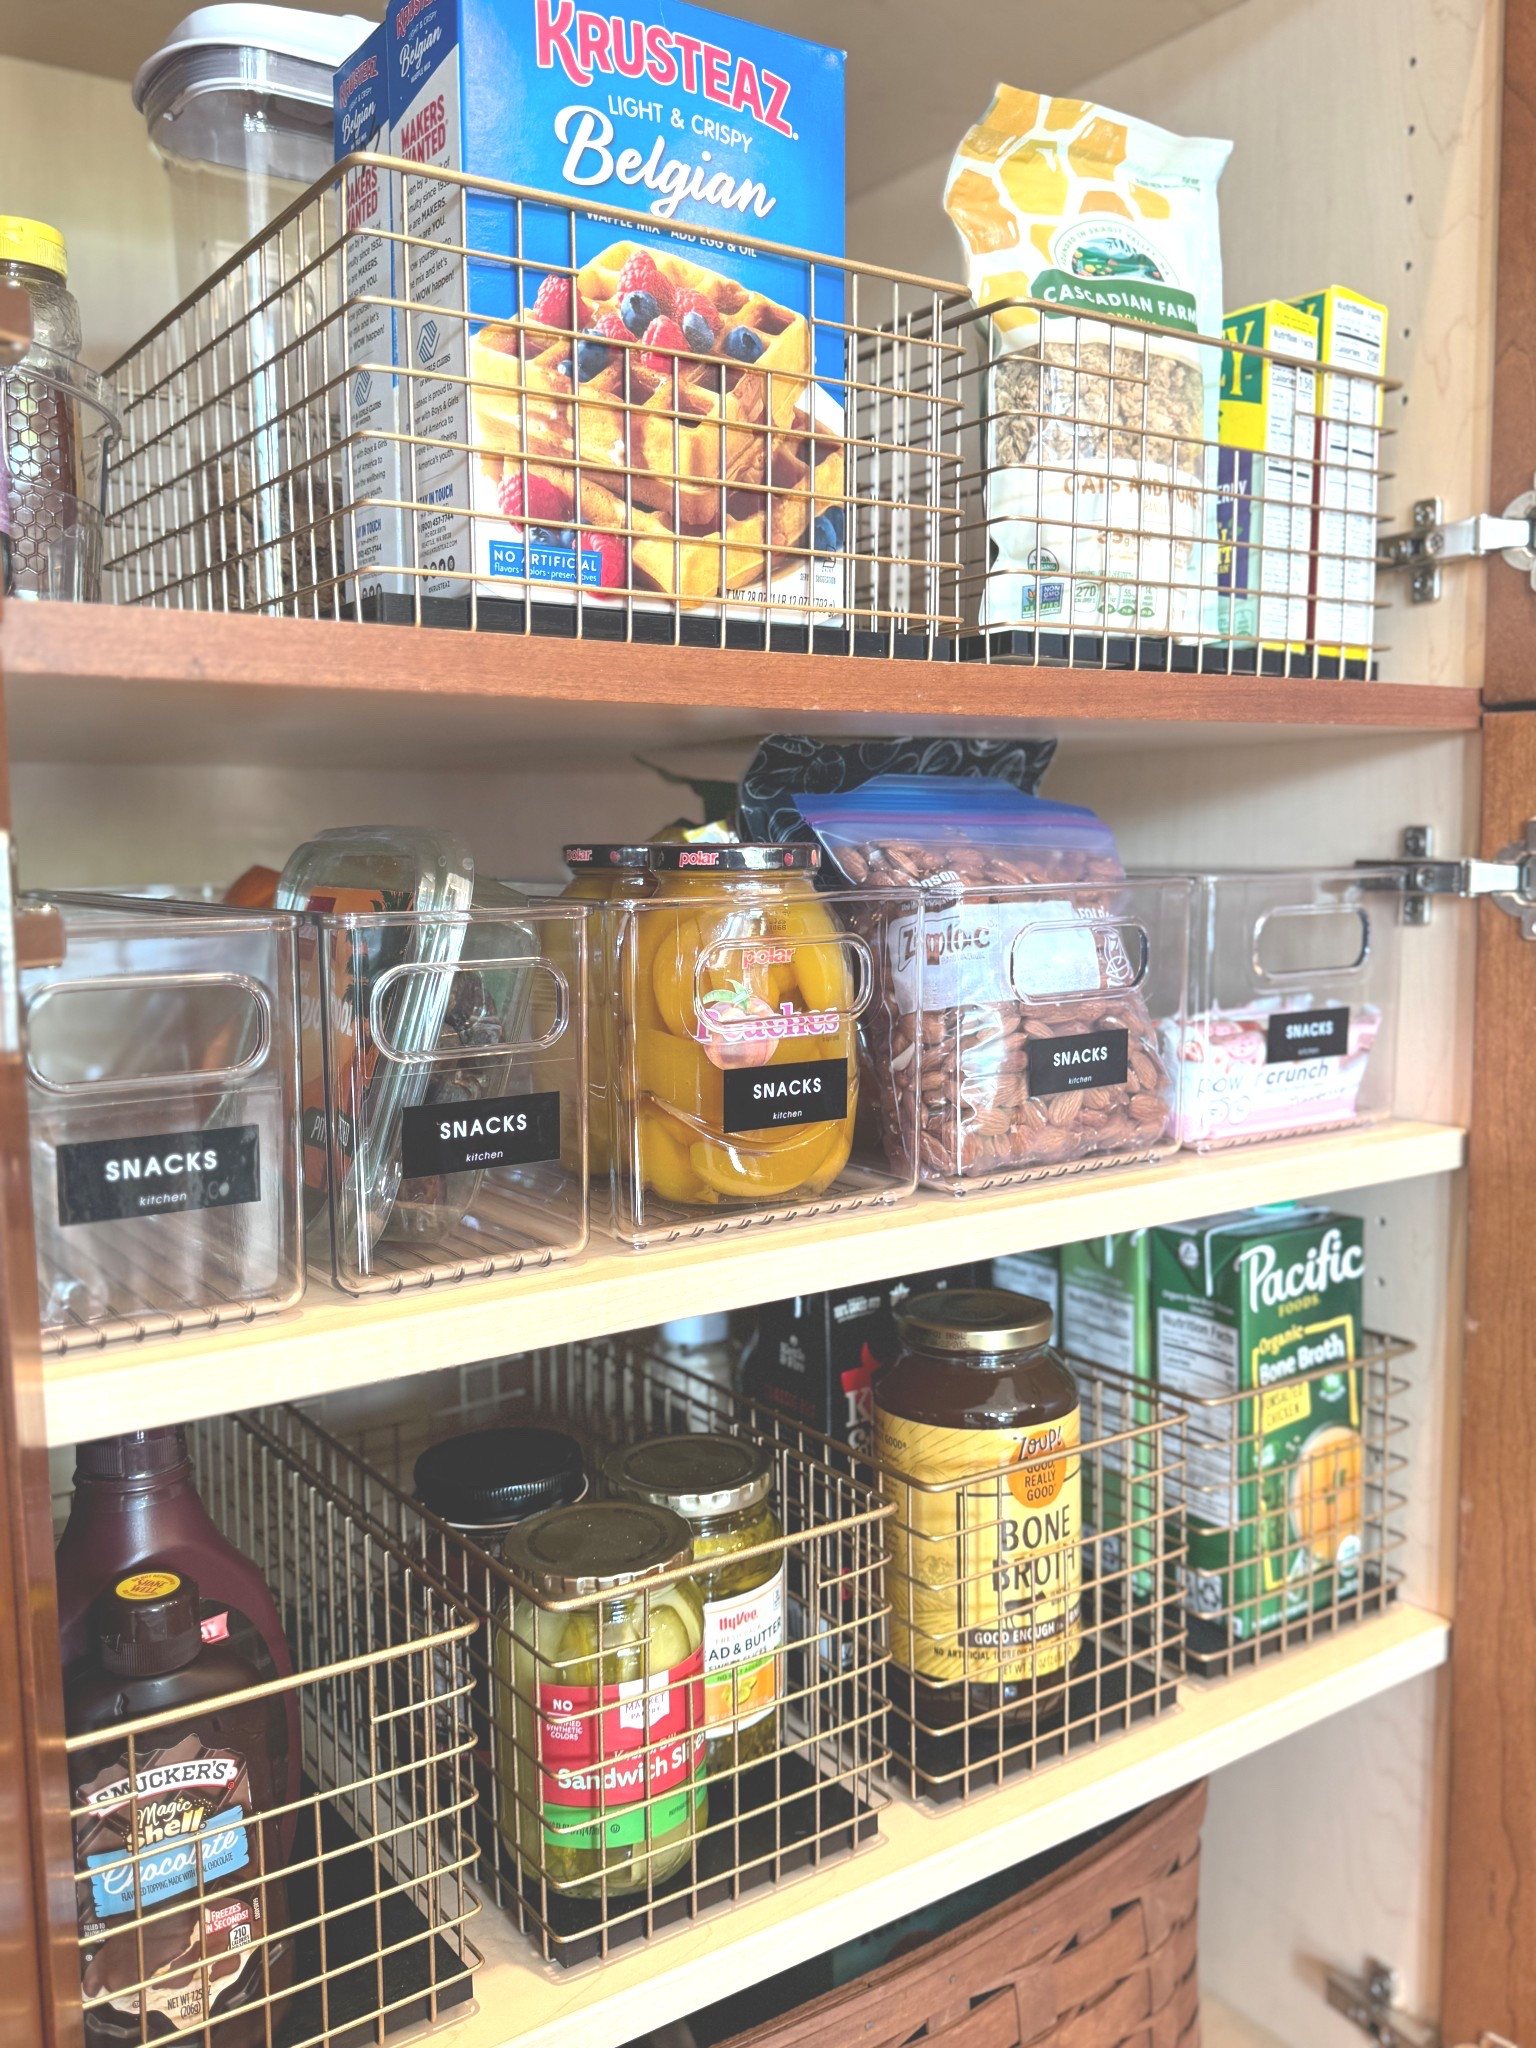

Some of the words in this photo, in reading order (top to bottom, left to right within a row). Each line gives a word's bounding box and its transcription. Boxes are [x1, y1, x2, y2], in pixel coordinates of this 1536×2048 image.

[400, 26, 442, 77] Belgian
[401, 94, 445, 149] MAKERS
[608, 97, 663, 125] LIGHT
[672, 108, 685, 128] &
[691, 114, 753, 153] CRISPY
[553, 103, 776, 219] Belgian
[431, 270, 455, 293] happen!
[1043, 284, 1153, 314] CASCADIAN
[1157, 300, 1197, 324] FARM
[435, 483, 454, 502] TOUCH
[494, 549, 516, 563] NO
[521, 553, 597, 572] RTIFICAL
[494, 561, 520, 574] flavors
[1075, 585, 1097, 598] 270
[679, 851, 717, 867] polar
[742, 947, 796, 970] polar
[1285, 1020, 1334, 1040] SNACKS
[1053, 1046, 1108, 1067] SNACKS
[1068, 1074, 1093, 1085] kitchen
[1265, 1060, 1329, 1086] crunch
[753, 1077, 822, 1100] SNACKS
[440, 1113, 527, 1140] SNACKS
[772, 1110, 803, 1120] kitchen
[105, 1149, 218, 1182] SNACKS
[465, 1150, 504, 1163] kitchen
[138, 1192, 187, 1207] kitchen
[1233, 1228, 1365, 1314] Pacific
[1277, 1293, 1321, 1318] FOODS
[1259, 1357, 1297, 1386] Bone
[1297, 1333, 1345, 1371] Broth
[1024, 1469, 1056, 1488] REALLY
[1026, 1484, 1054, 1502] GOOD
[1002, 1504, 1071, 1552] BONE
[130, 1584, 158, 1593] WELL
[733, 1642, 742, 1656] &
[745, 1616, 782, 1650] BUTTER
[553, 1699, 573, 1712] NO
[546, 1723, 583, 1735] SYNTHETIC
[550, 1731, 579, 1741] COLORS
[95, 1761, 228, 1802] SMUCKER'S
[558, 1757, 668, 1790] Sandwich
[137, 1799, 192, 1829] Magic
[147, 1880, 169, 1894] TOPPING
[168, 1876, 183, 1889] MADE
[208, 1852, 234, 1872] CHOCOLATE
[211, 1902, 242, 1921] FREEZES
[213, 1908, 249, 1931] SECONDS!
[99, 1922, 106, 1930] TO
[233, 1926, 247, 1940] 210
[167, 1998, 180, 2010] NET
[180, 1993, 190, 2006] WT
[180, 2003, 201, 2018] (206g)
